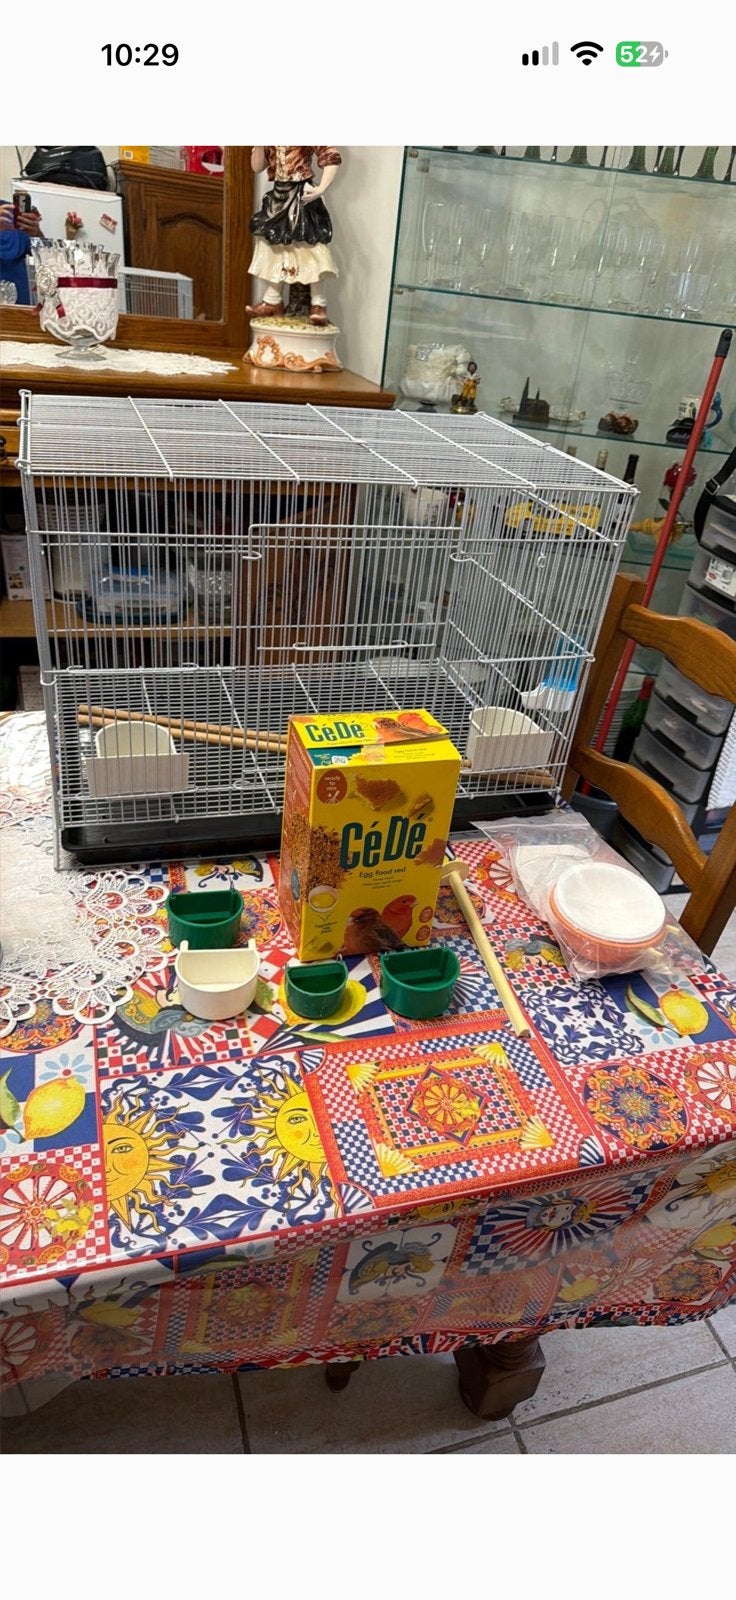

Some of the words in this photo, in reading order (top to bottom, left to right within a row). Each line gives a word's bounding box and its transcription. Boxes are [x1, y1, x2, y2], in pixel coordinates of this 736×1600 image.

[305, 720, 366, 743] CéDé
[340, 813, 427, 870] CéDé
[359, 871, 373, 879] Egg
[375, 868, 393, 876] food
